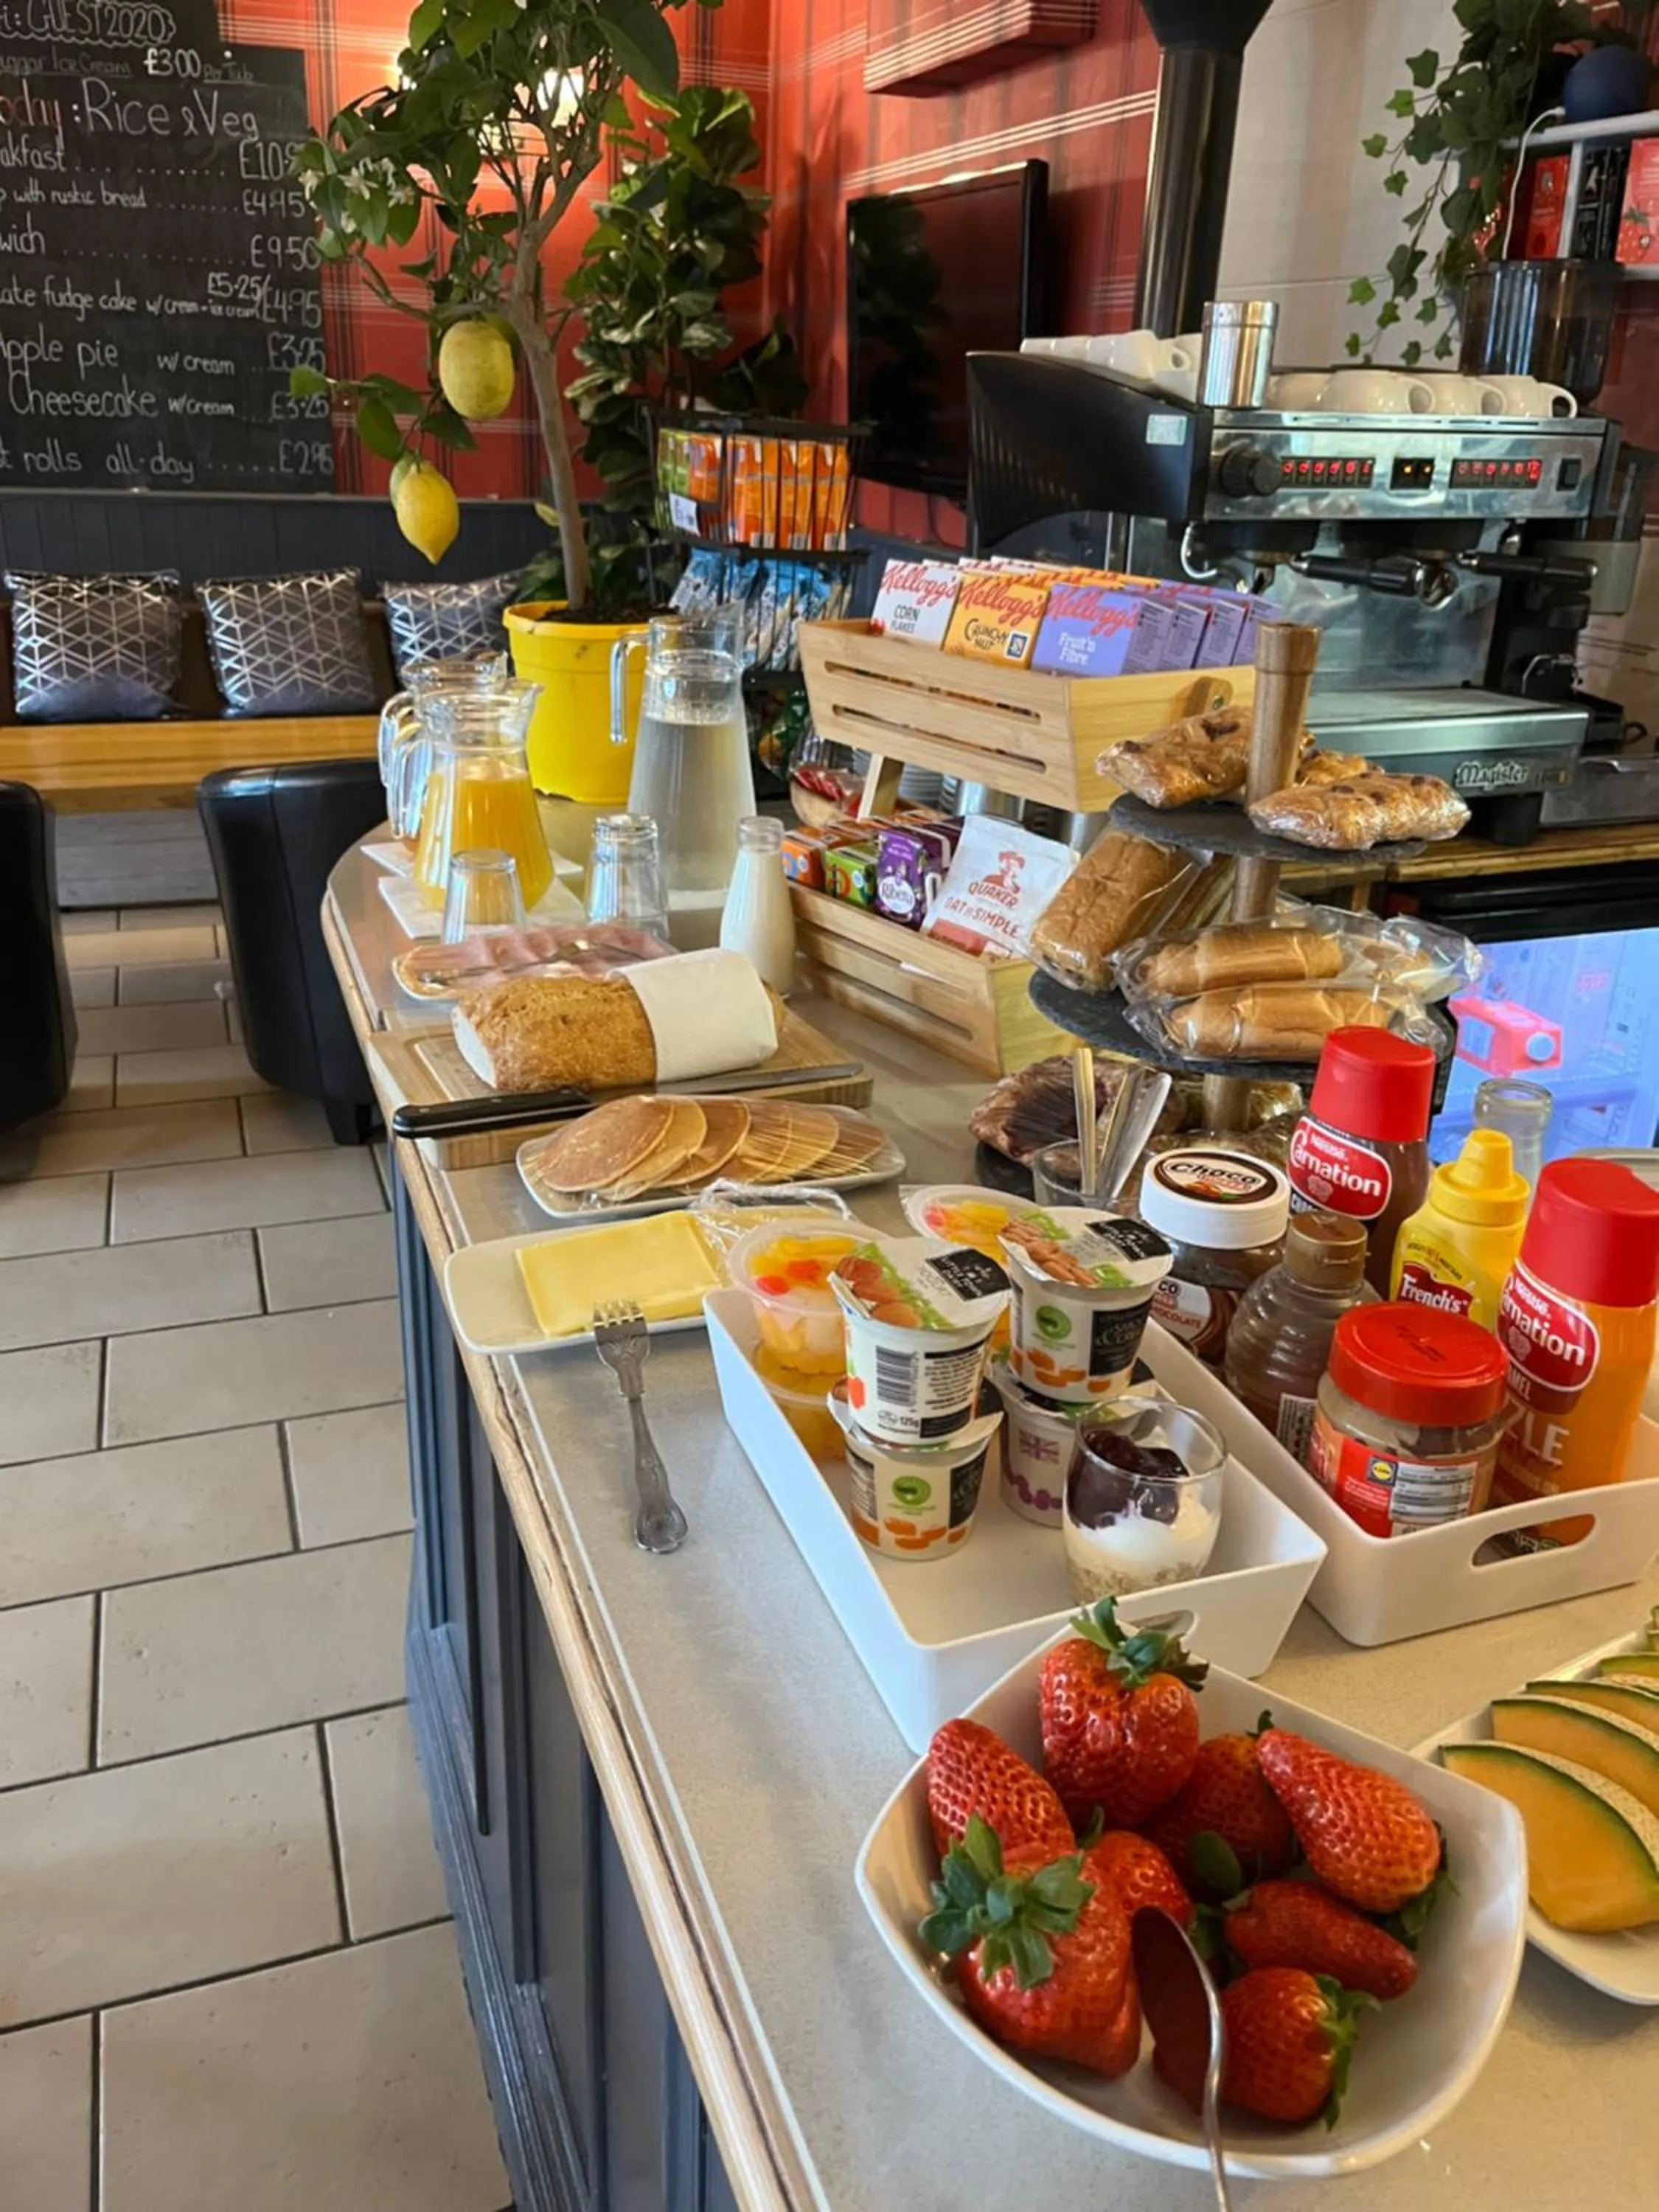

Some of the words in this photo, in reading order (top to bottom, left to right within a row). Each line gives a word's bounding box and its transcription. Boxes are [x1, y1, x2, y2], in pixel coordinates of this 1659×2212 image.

[193, 88, 260, 142] Veg
[44, 274, 94, 322] fudge
[99, 278, 138, 312] cake
[77, 340, 119, 380] pie
[9, 369, 159, 419] Cheesecake
[24, 437, 83, 473] rolls
[882, 561, 958, 607] Kellogg's
[959, 577, 1047, 627] Kellogg's
[894, 604, 921, 622] CORN
[1048, 588, 1140, 638] Kellogg's
[968, 881, 1018, 908] QUAKER
[973, 908, 1022, 939] SIMPLE
[1167, 1162, 1259, 1184] Choco
[1290, 1129, 1382, 1197] Carnation
[1402, 1273, 1461, 1314] French's
